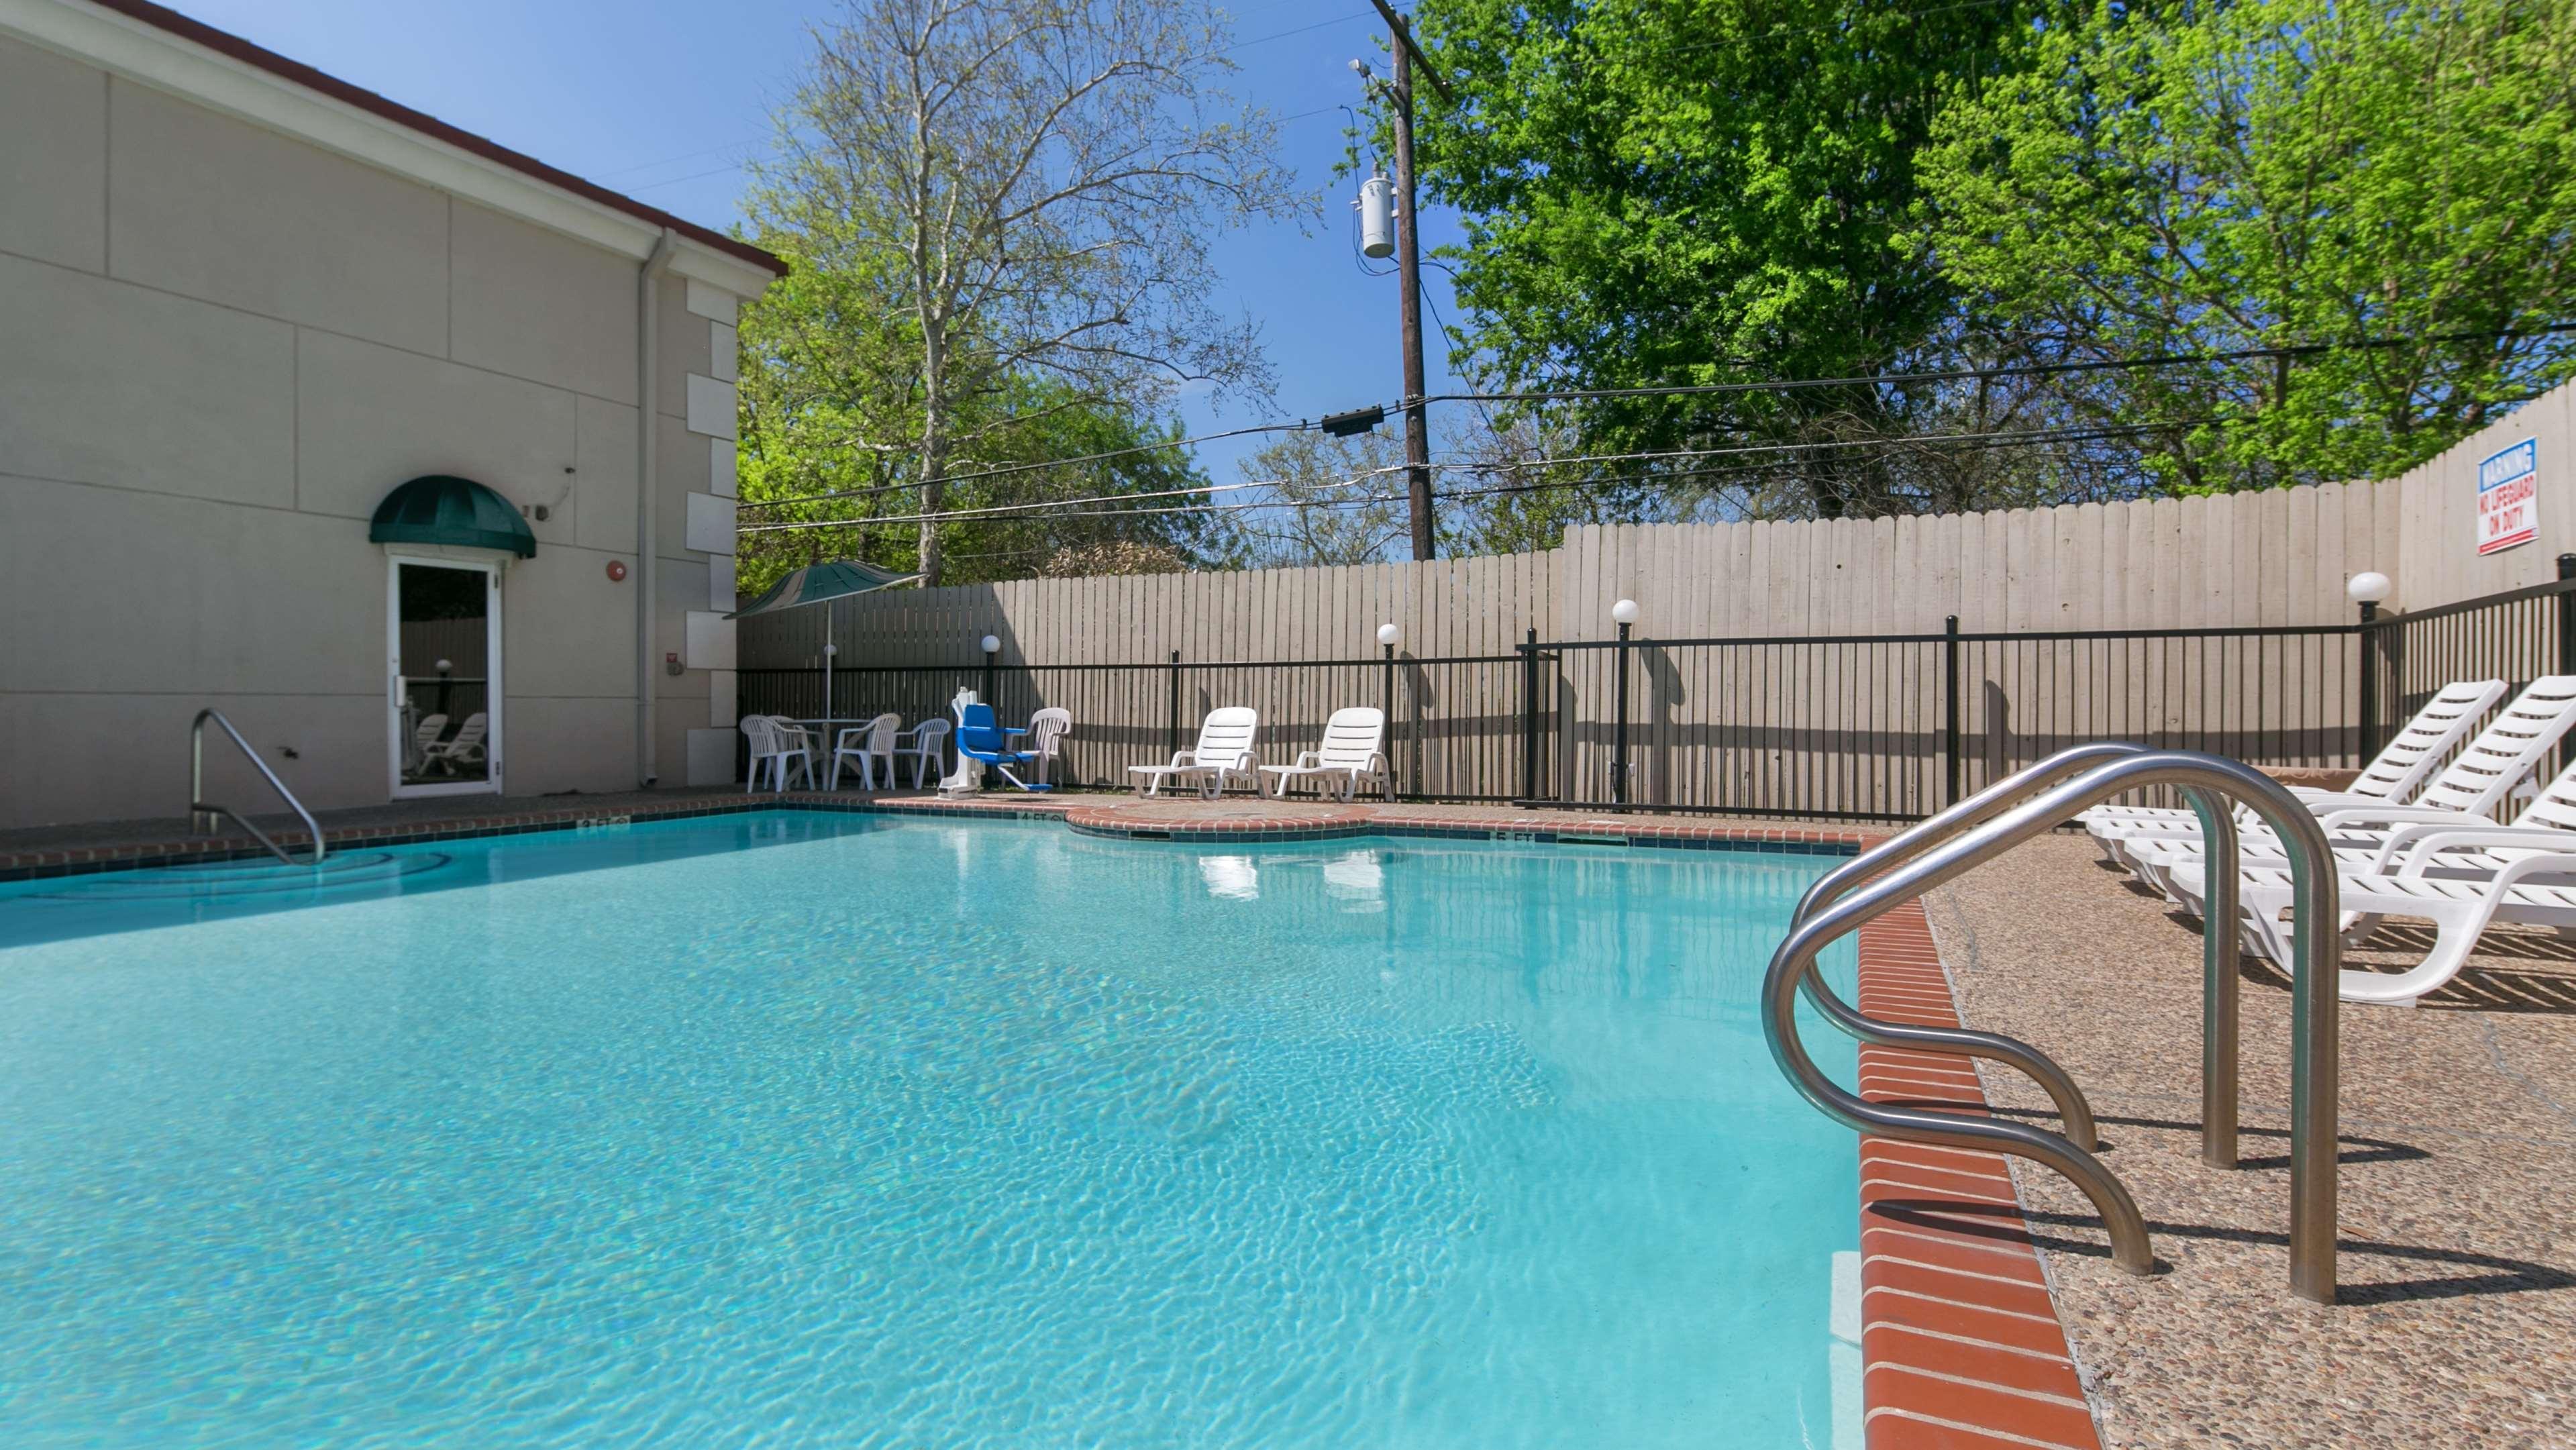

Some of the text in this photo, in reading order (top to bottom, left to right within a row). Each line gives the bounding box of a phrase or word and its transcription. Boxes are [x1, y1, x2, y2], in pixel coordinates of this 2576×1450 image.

[2483, 444, 2532, 489] WARNING
[2480, 474, 2534, 515] NO LIFEGUARD
[2490, 505, 2524, 537] ON DUTY
